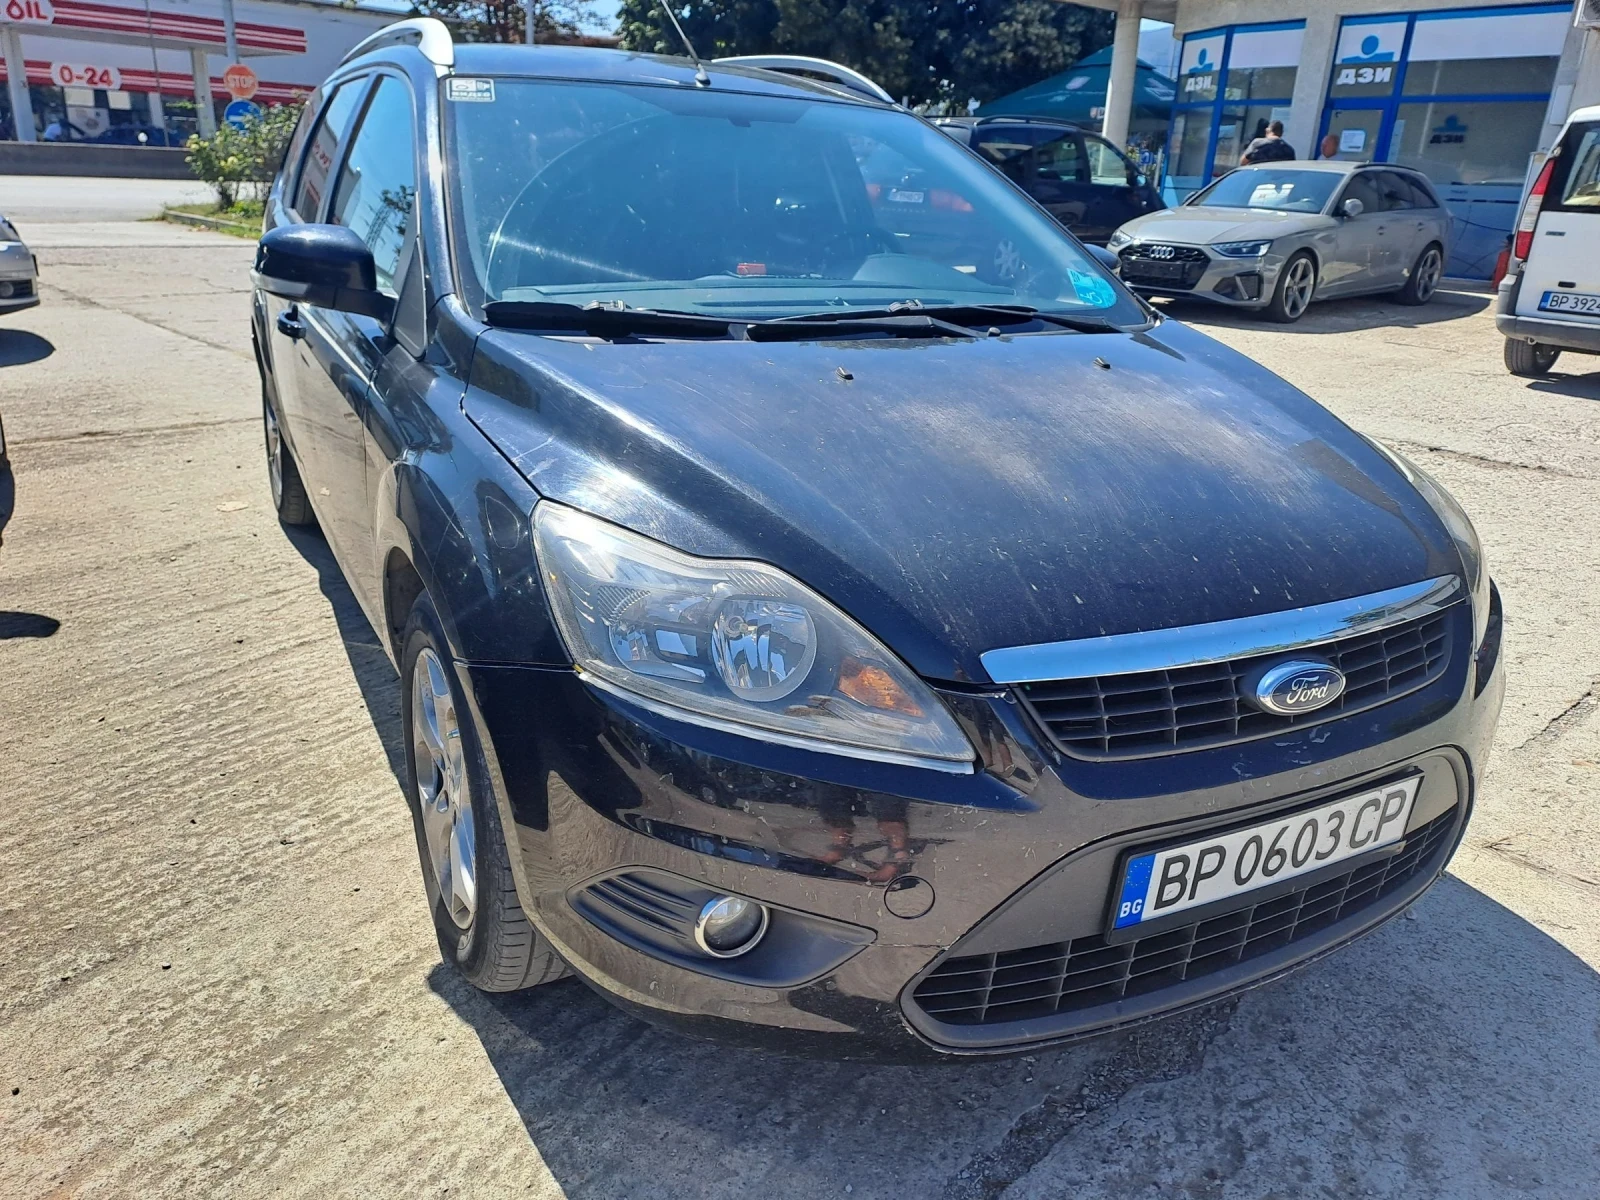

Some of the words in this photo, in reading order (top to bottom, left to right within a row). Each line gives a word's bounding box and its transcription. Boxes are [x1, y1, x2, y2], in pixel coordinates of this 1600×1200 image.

[6, 0, 48, 20] OIL
[60, 65, 113, 86] 0-24
[227, 75, 256, 88] STOP
[1185, 75, 1213, 92] ДЗИ
[1336, 67, 1392, 85] ДЗИ
[1549, 294, 1569, 308] BP
[1286, 676, 1330, 704] Ford
[1153, 845, 1226, 910] BP
[1233, 810, 1344, 886] 0603
[1349, 789, 1407, 849] CP
[1119, 898, 1143, 918] BG
